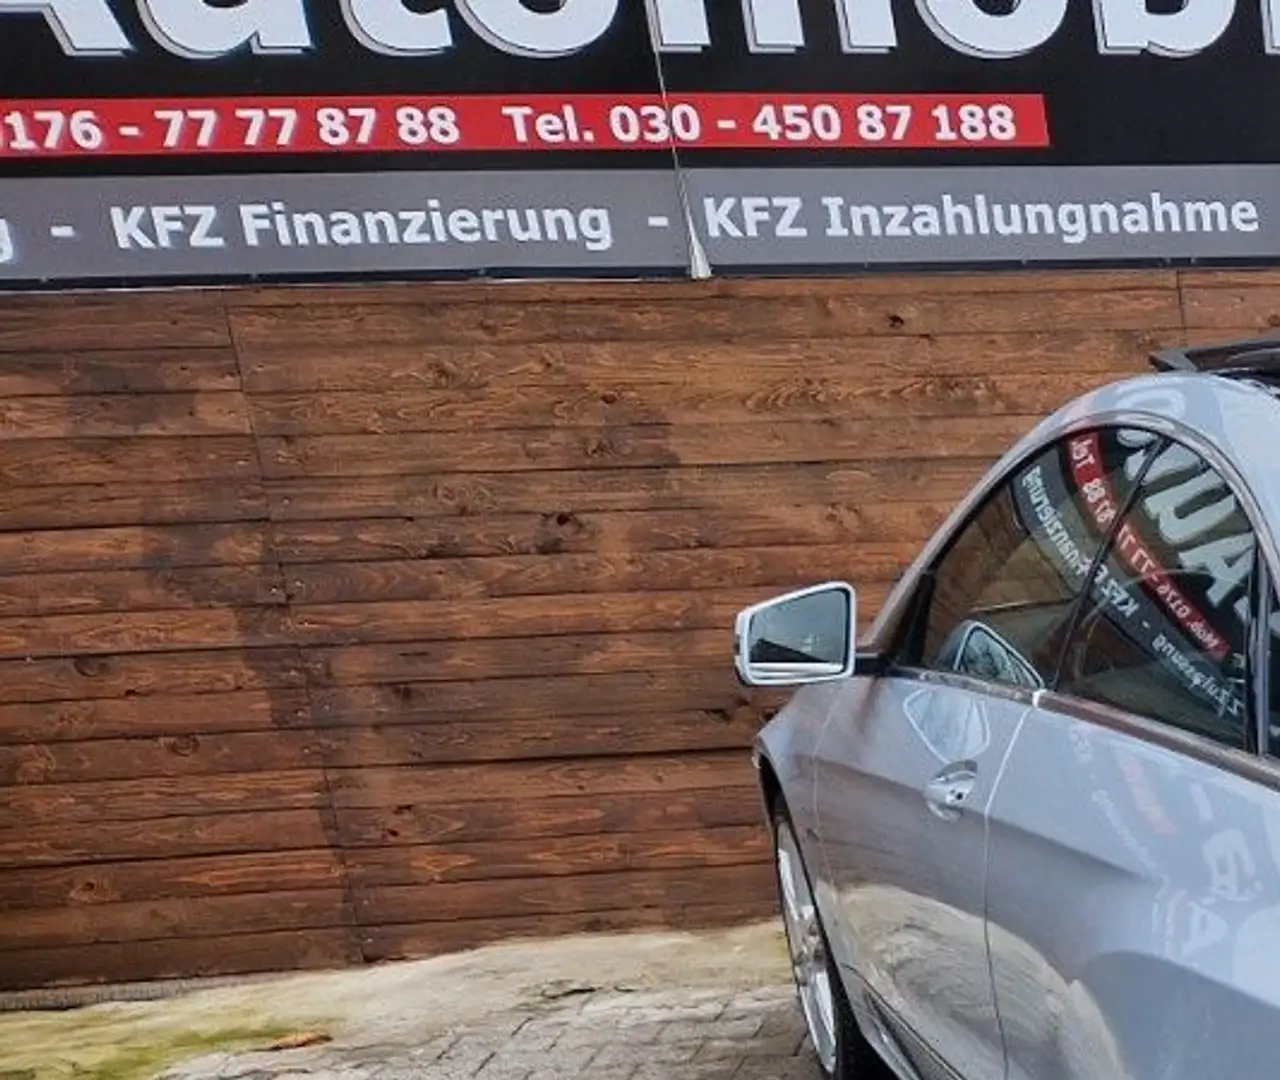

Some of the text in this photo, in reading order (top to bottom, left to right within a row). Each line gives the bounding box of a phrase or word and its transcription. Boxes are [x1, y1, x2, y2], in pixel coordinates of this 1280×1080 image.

[0, 109, 103, 149] 176
[154, 109, 218, 147] 77
[235, 108, 297, 146] 77
[316, 107, 377, 146] 87
[395, 105, 460, 144] 88
[501, 104, 594, 143] Tel.
[609, 103, 700, 142] 030
[752, 104, 841, 141] 450
[857, 103, 912, 140] 87
[931, 103, 1017, 141] 188
[110, 205, 226, 249] KFZ
[239, 199, 613, 252] Finanzierung
[703, 197, 808, 238] KFZ
[821, 193, 1260, 245] Inzahlungnahme
